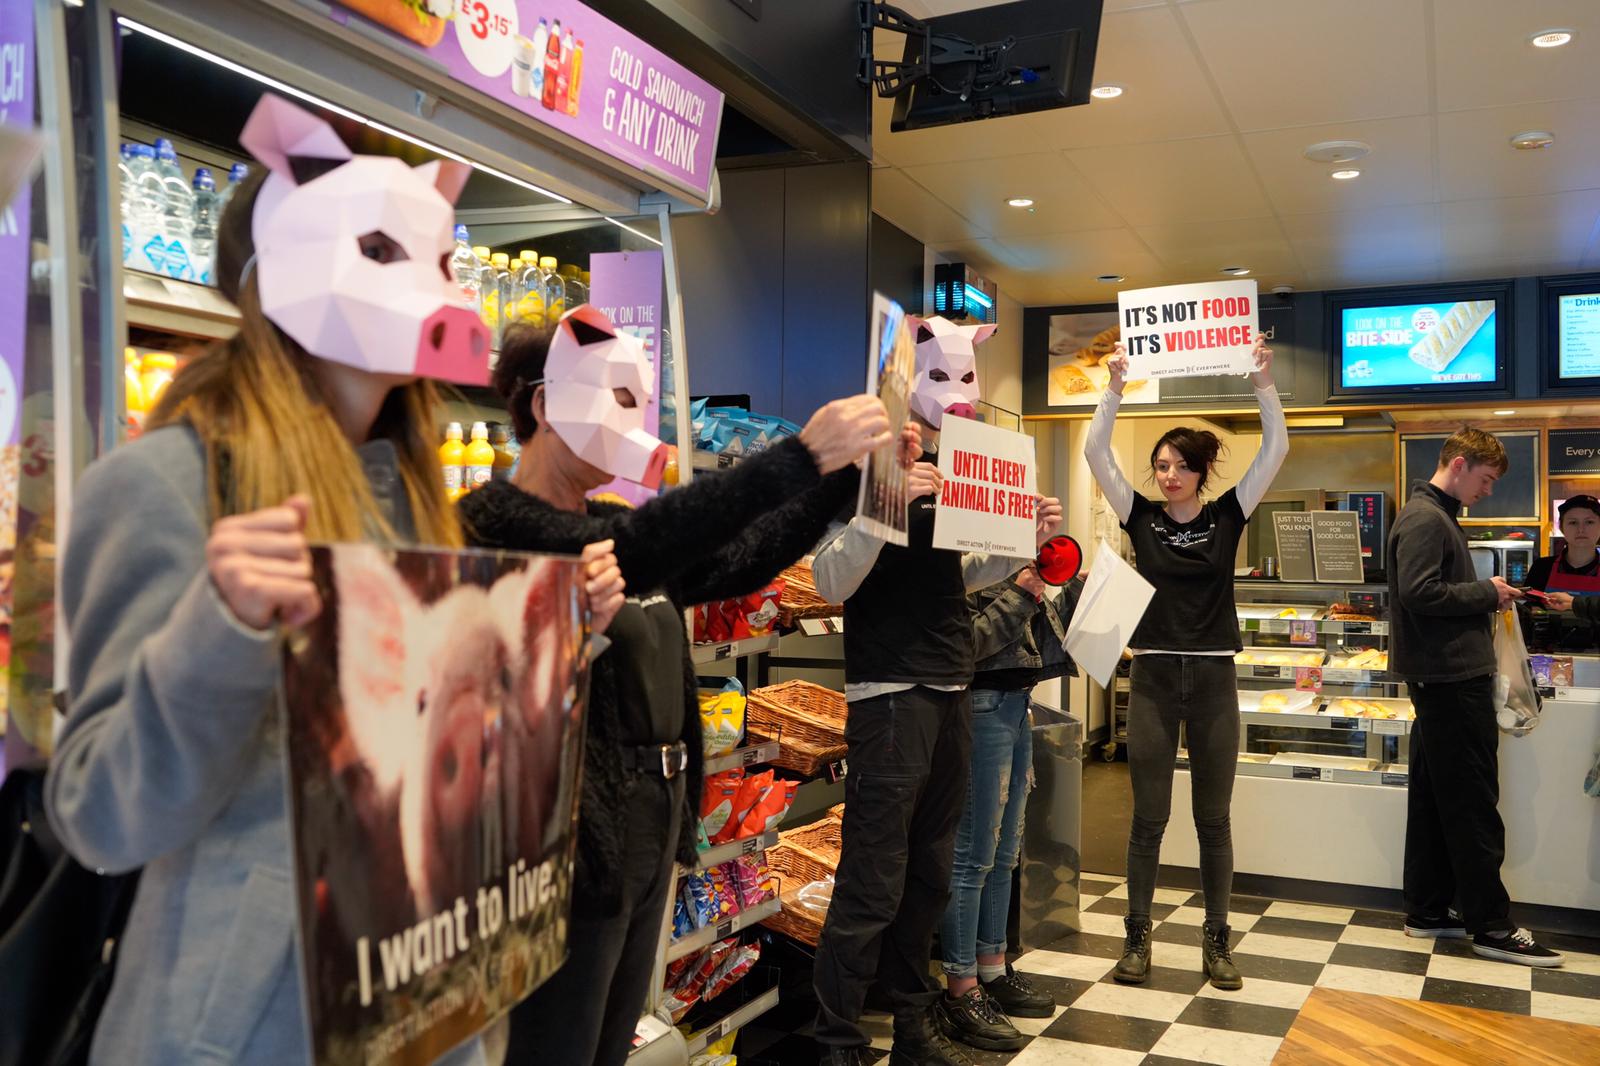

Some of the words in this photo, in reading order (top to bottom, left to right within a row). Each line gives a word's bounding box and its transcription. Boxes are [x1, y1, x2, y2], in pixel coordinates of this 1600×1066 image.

[609, 46, 643, 91] COLD
[644, 67, 706, 128] SANDWICH
[602, 87, 616, 131] &
[617, 91, 656, 150] ANY
[654, 112, 699, 175] DRINK
[620, 307, 633, 324] ON
[637, 305, 654, 323] THE
[1125, 305, 1158, 328] IT'S
[1162, 301, 1198, 324] NOT
[1202, 296, 1250, 320] FOOD
[1375, 317, 1387, 329] ON
[1389, 316, 1403, 328] THE
[1128, 333, 1161, 356] IT'S
[1164, 325, 1253, 353] VIOLENCE
[1346, 331, 1378, 347] BITE
[1380, 328, 1413, 346] SIDE
[1196, 363, 1231, 371] EVERYWHERE
[1566, 446, 1594, 458] Every
[953, 449, 989, 482] UNTIL
[992, 457, 1027, 489] EVERY
[940, 480, 990, 513] ANIMAL
[993, 488, 1006, 516] IS
[1008, 490, 1035, 520] FREE
[1277, 516, 1291, 524] JUST
[357, 935, 372, 1007] I
[378, 895, 470, 991] want
[476, 885, 503, 940] to
[509, 857, 558, 922] live.
